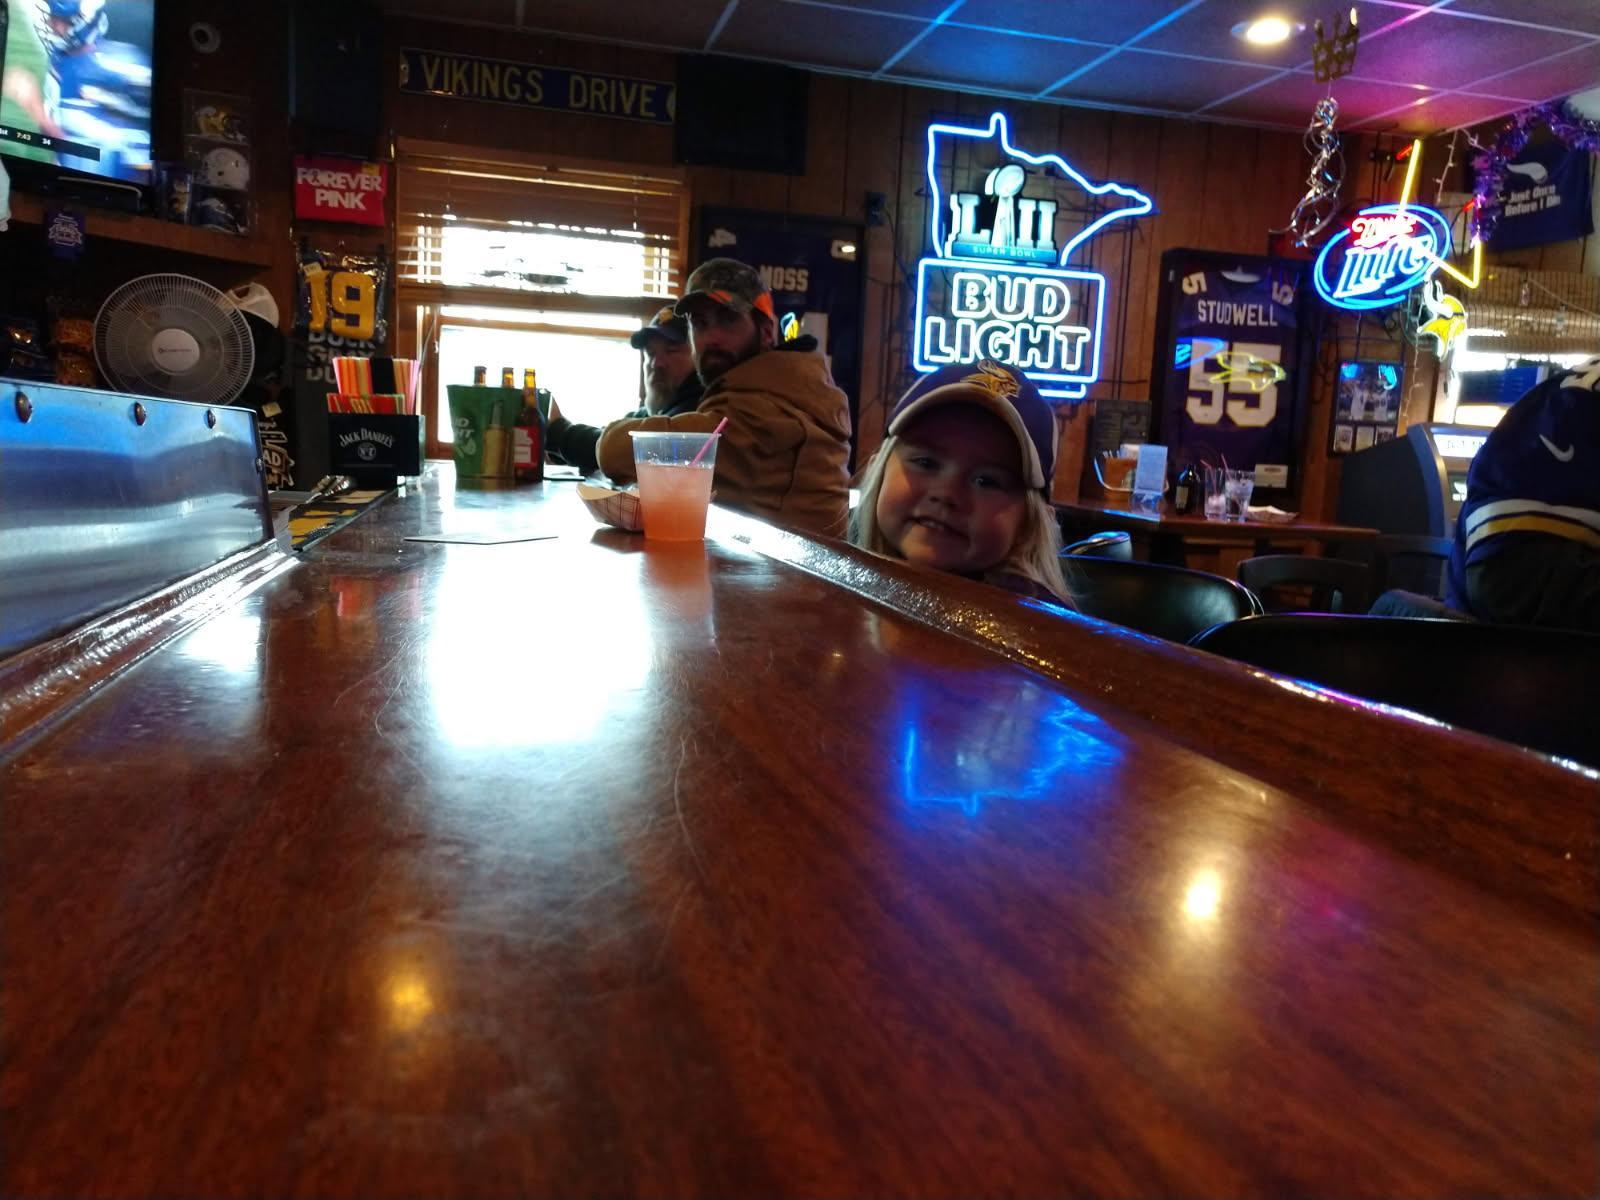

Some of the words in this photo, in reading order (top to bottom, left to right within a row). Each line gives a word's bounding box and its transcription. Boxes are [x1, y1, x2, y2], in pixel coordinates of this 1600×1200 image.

[420, 55, 544, 102] VIKINGS
[568, 75, 657, 117] DRIVE
[296, 167, 382, 191] FOREVER
[315, 188, 368, 210] PINK
[1505, 201, 1538, 216] Before
[972, 246, 1006, 255] SUPER
[1009, 248, 1036, 258] BOWL
[759, 264, 809, 292] MOSS
[304, 269, 375, 340] 19
[952, 272, 1070, 323] BUD
[1197, 299, 1278, 327] STUDWELL
[924, 316, 1091, 371] LIGHT
[1185, 338, 1282, 427] 55
[339, 432, 361, 448] JACK
